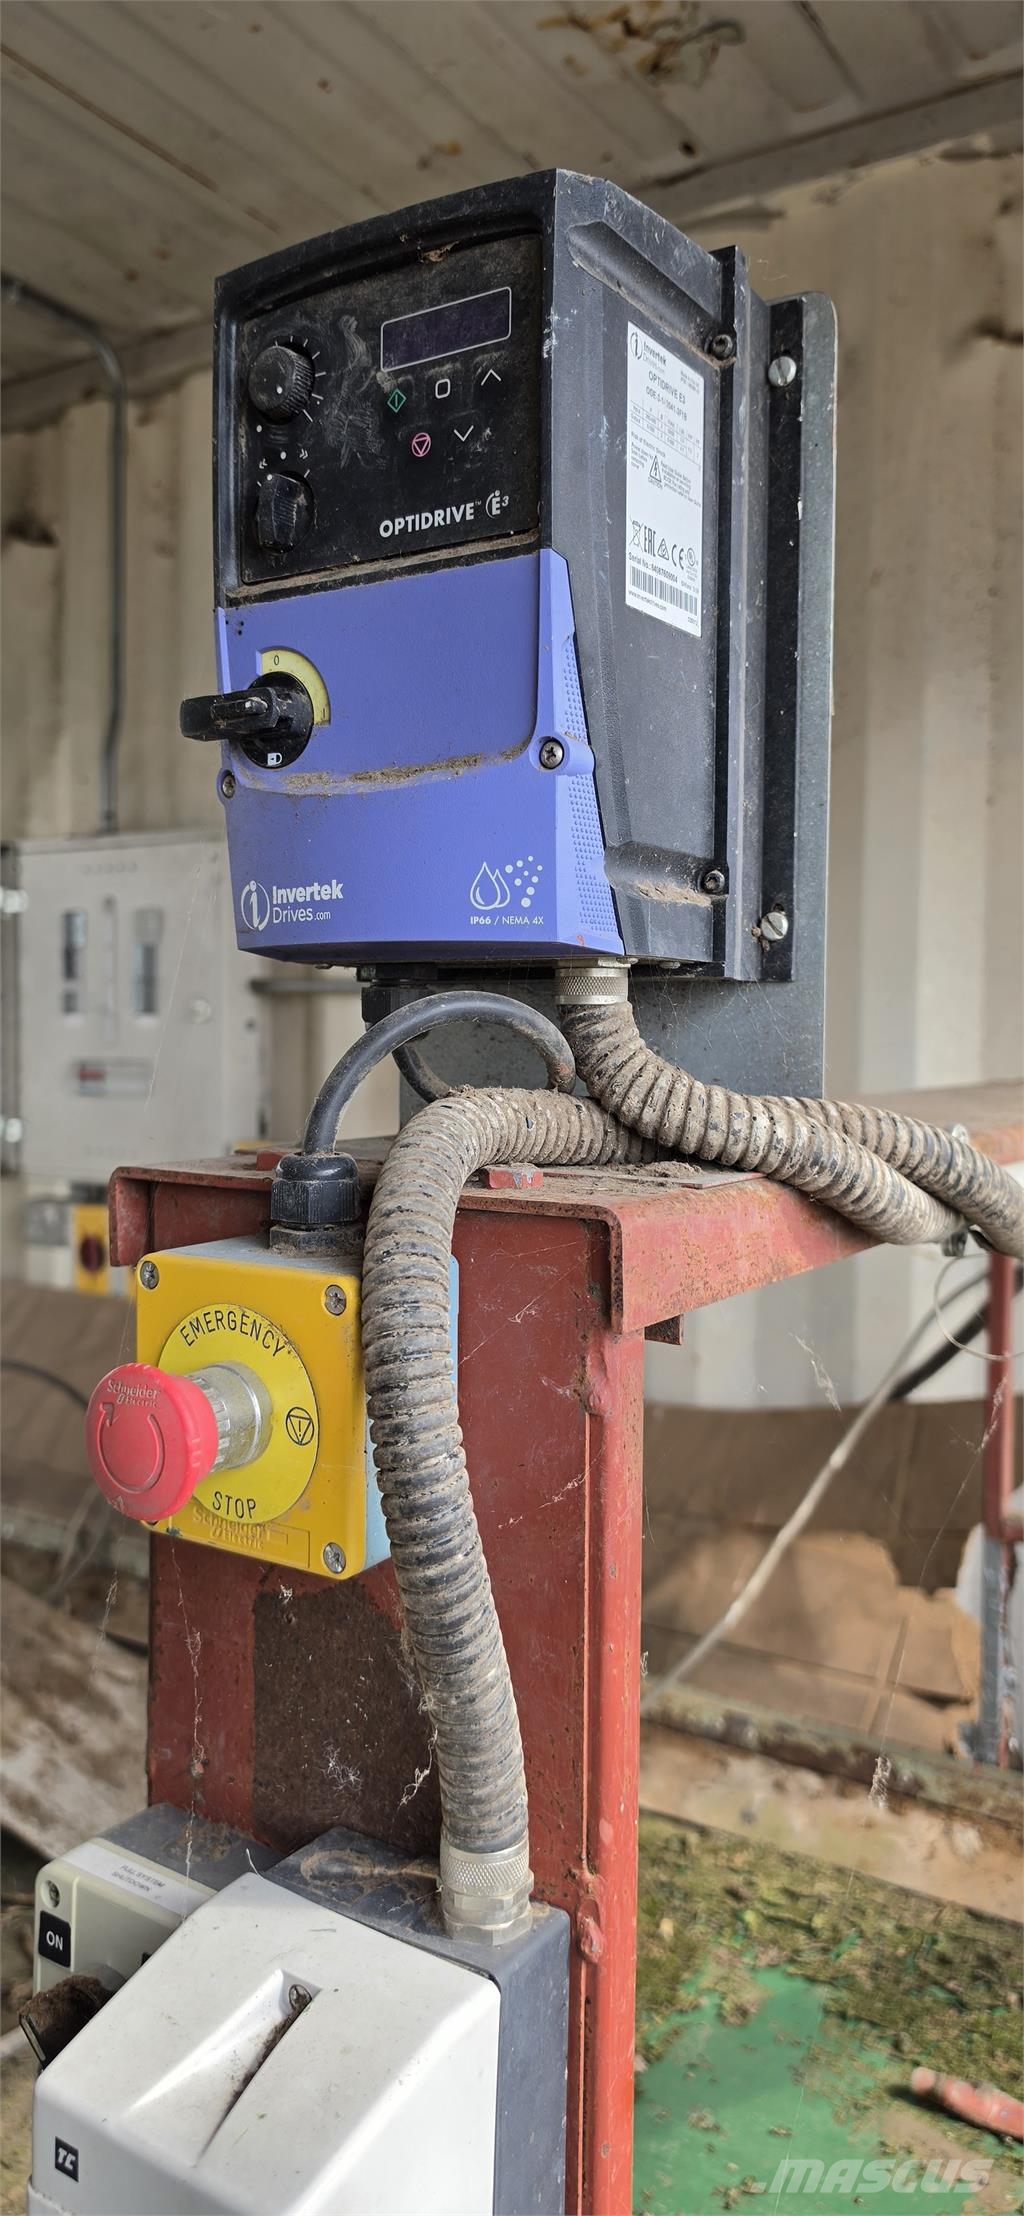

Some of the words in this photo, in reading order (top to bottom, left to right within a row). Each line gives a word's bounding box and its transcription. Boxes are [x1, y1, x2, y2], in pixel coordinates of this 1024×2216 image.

[272, 879, 344, 905] Invertek
[470, 915, 492, 925] IP66
[502, 915, 530, 925] NEMA
[532, 915, 544, 925] 4X
[179, 1309, 286, 1357] EMERGENCY
[106, 1379, 158, 1400] Schneider
[212, 1491, 257, 1519] STOP
[46, 1930, 63, 1951] ON
